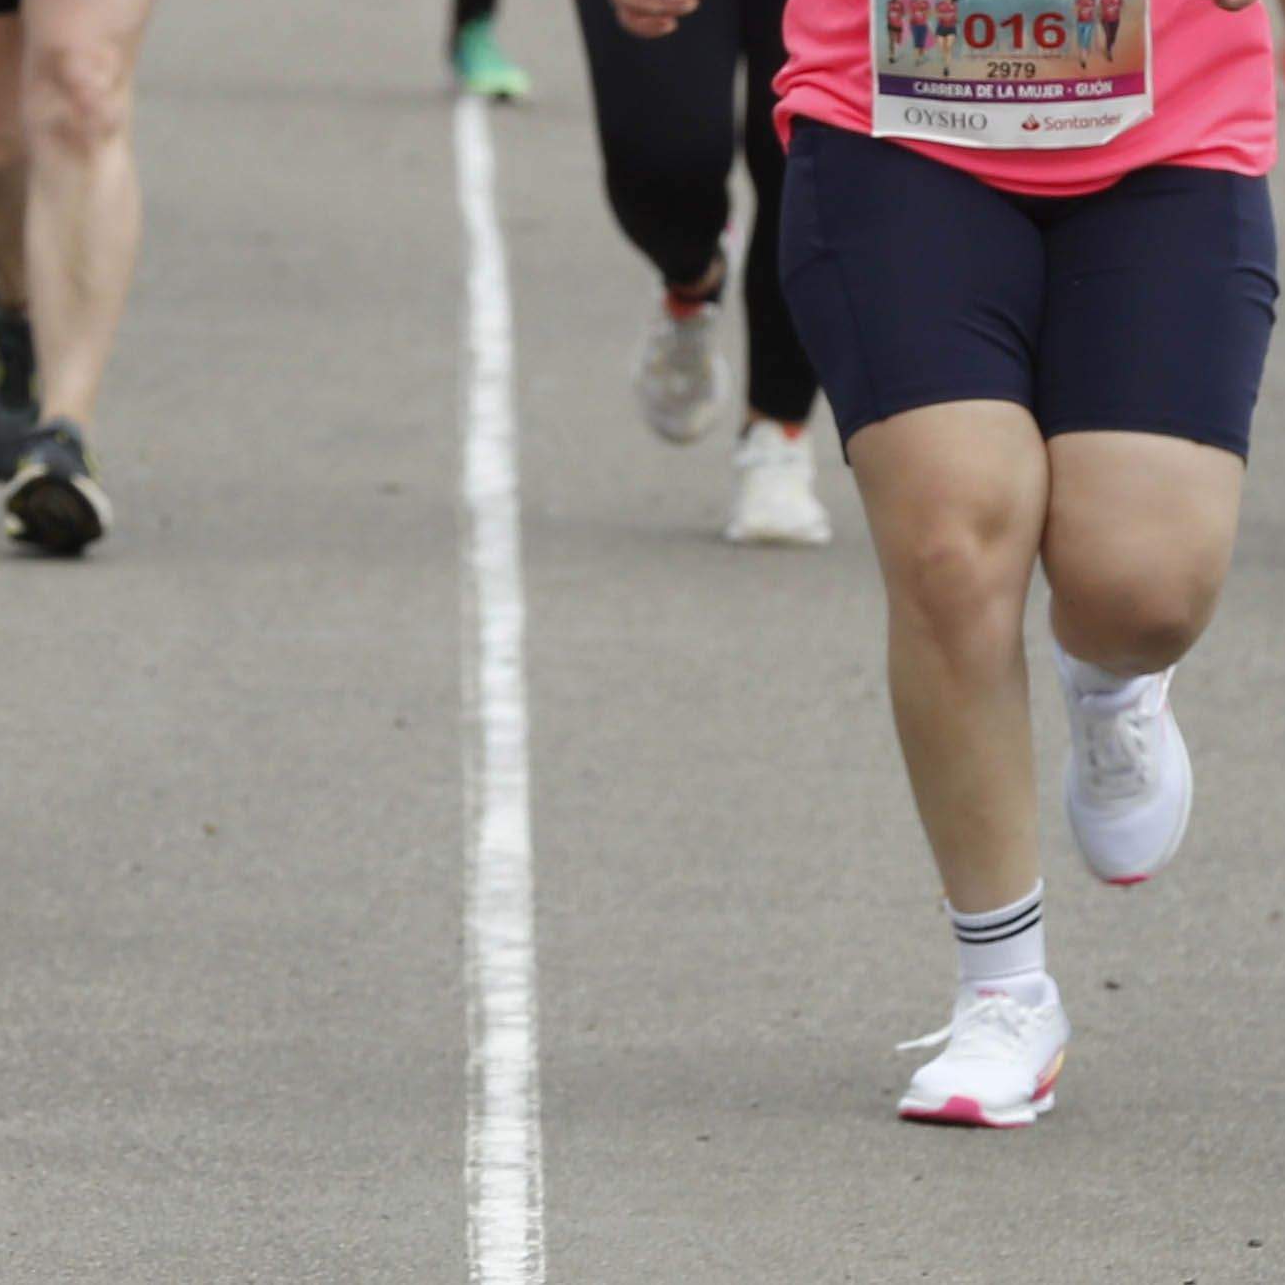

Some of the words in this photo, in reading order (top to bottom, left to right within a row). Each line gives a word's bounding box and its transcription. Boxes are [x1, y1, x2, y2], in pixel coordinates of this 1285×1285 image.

[963, 11, 1067, 50] 016
[987, 61, 1036, 78] 2979
[914, 81, 973, 98] CARRERA
[976, 84, 994, 99] DE
[997, 84, 1015, 99] LA
[1018, 83, 1064, 98] MUJER
[904, 106, 988, 131] OYSHO
[1043, 114, 1122, 132] Santander
